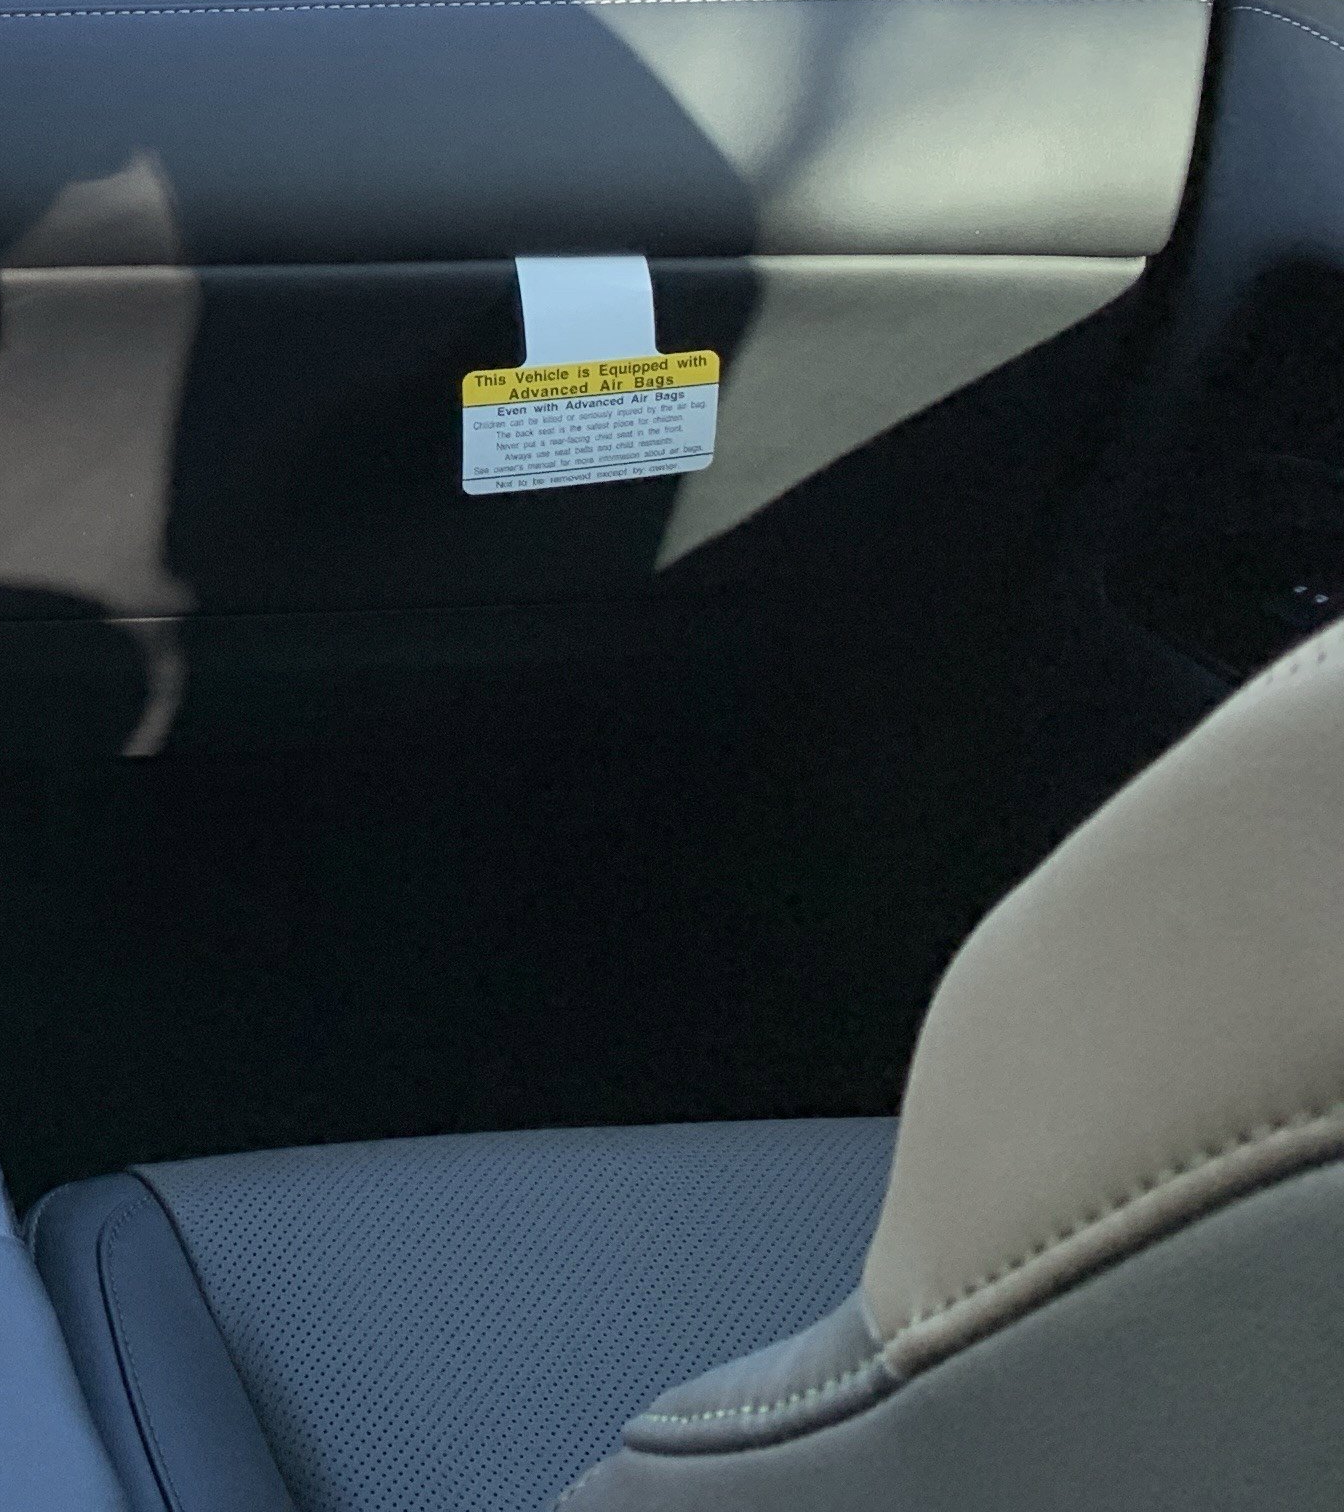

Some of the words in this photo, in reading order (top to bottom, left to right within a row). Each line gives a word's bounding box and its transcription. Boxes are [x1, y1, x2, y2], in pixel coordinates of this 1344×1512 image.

[475, 373, 506, 387] This
[515, 369, 569, 383] Vehicle
[578, 366, 590, 378] is
[599, 359, 668, 377] Equipped
[677, 355, 707, 368] with
[509, 382, 588, 400] Advanced
[600, 379, 623, 391] Air
[634, 375, 674, 388] Bags
[497, 407, 527, 416] Even
[533, 402, 558, 413] with
[565, 396, 623, 409] Advanced
[631, 394, 648, 404] Air
[655, 391, 685, 402] Bags
[497, 431, 511, 439] The
